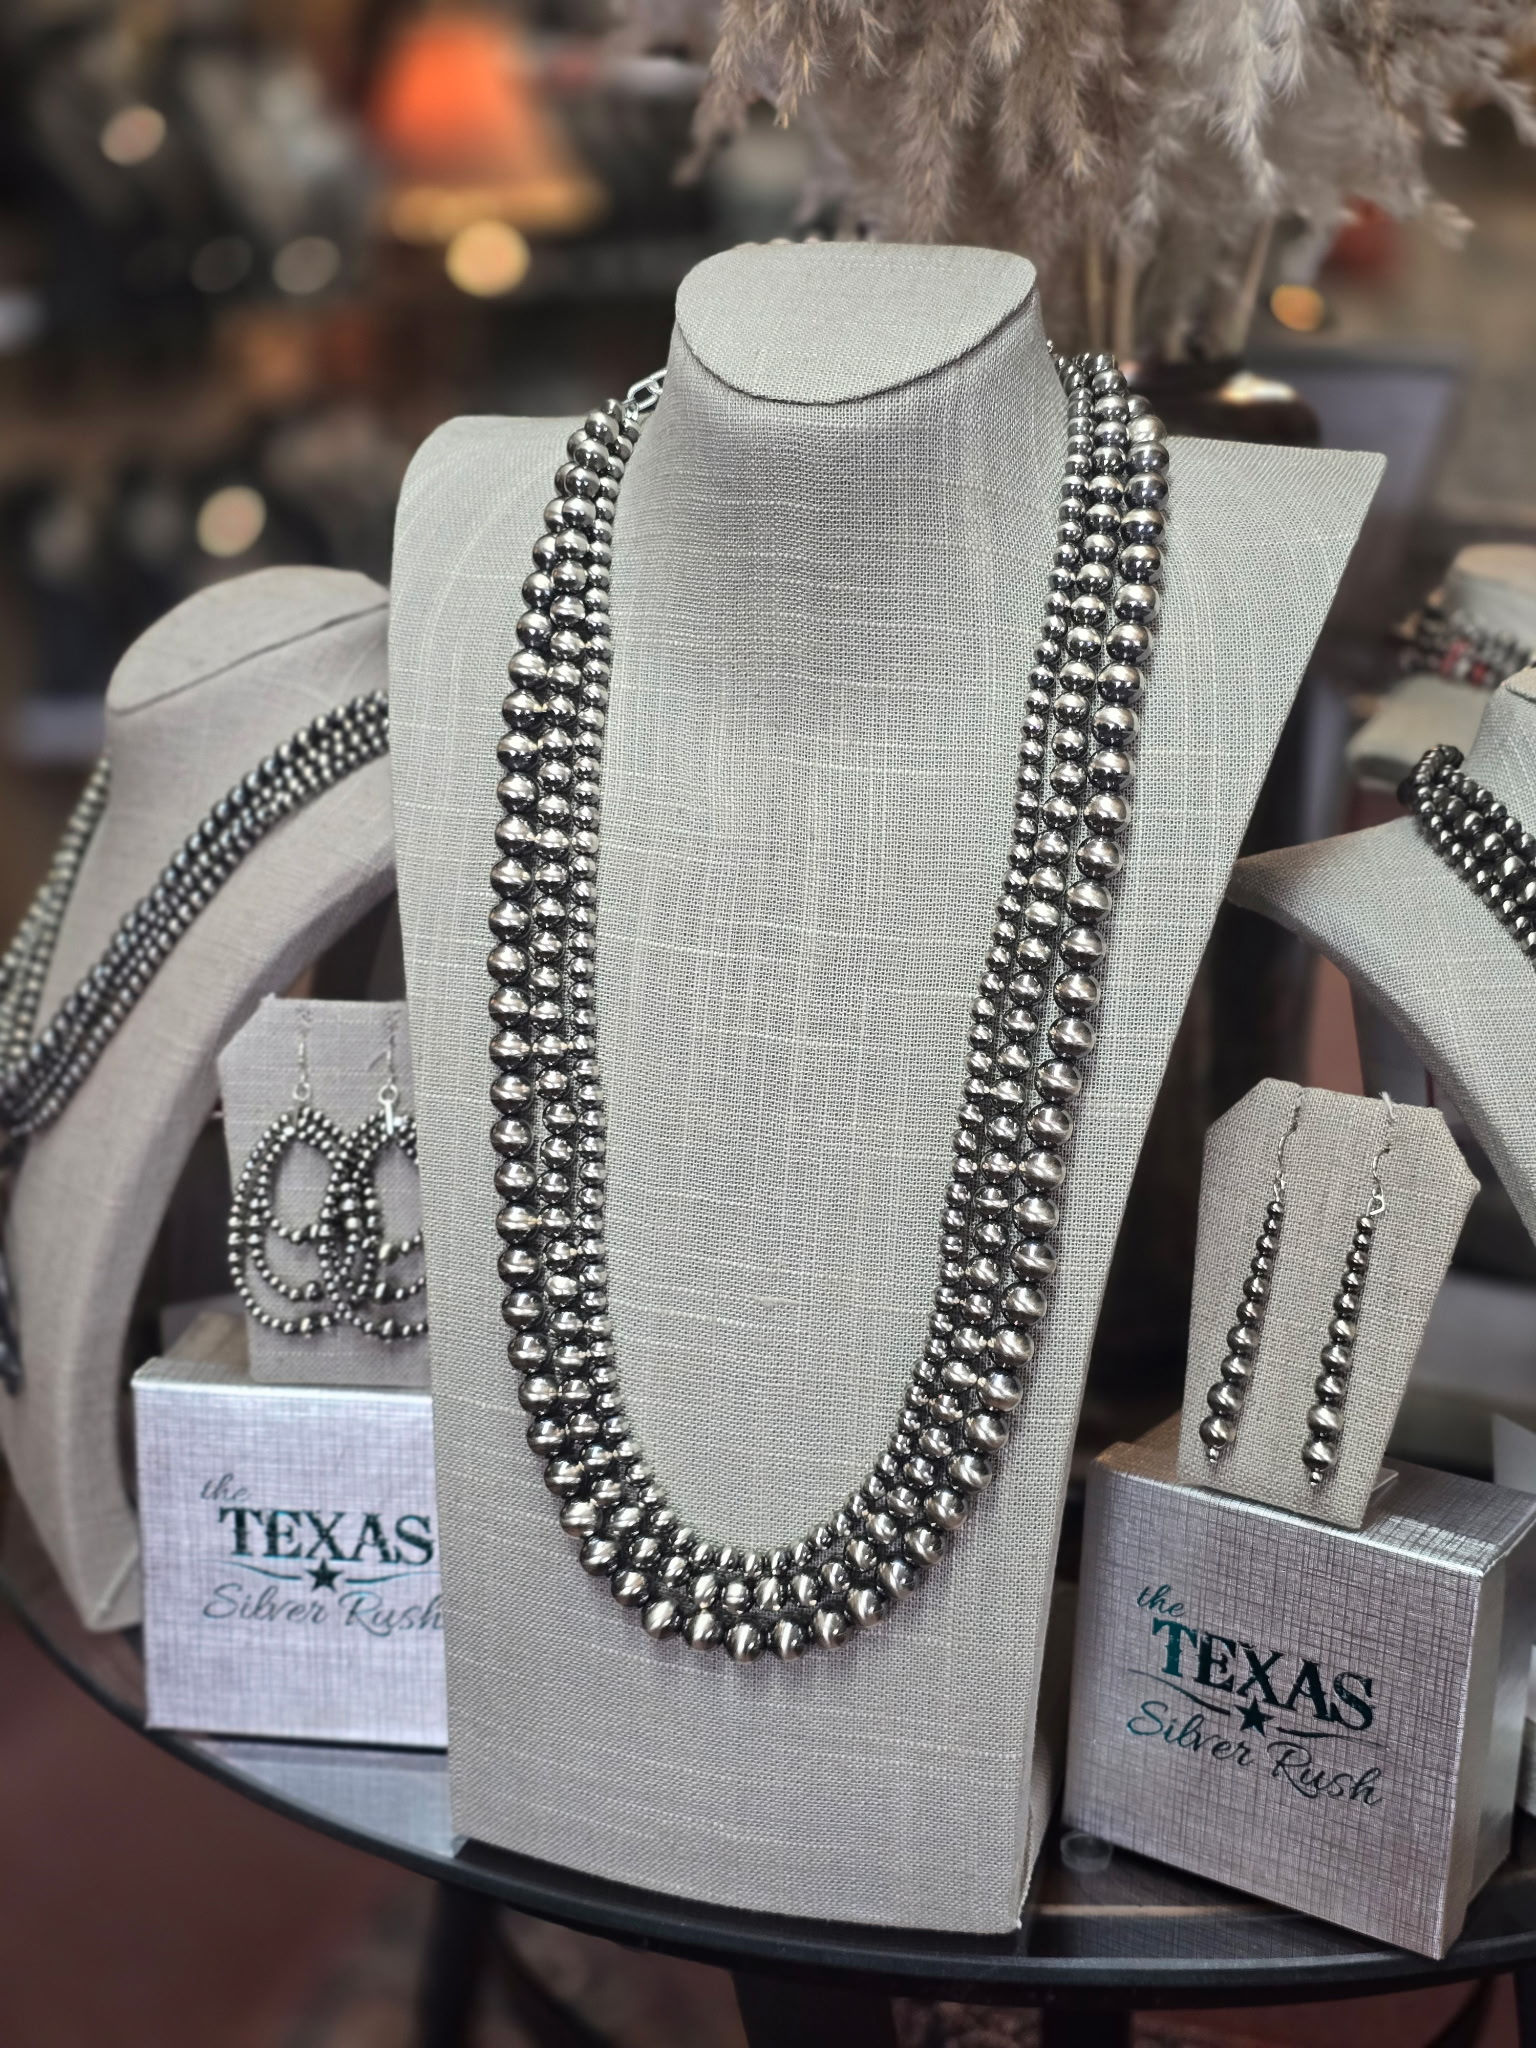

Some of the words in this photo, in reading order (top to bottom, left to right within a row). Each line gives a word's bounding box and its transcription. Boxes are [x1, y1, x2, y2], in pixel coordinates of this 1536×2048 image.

[200, 1473, 248, 1500] the
[218, 1507, 434, 1565] TEXAS
[203, 1583, 328, 1624] Silver
[338, 1591, 443, 1637] Rush
[1137, 1584, 1185, 1617] the
[1152, 1617, 1377, 1731] TEXAS
[1127, 1700, 1253, 1766] Silver
[1266, 1741, 1382, 1805] Rush
